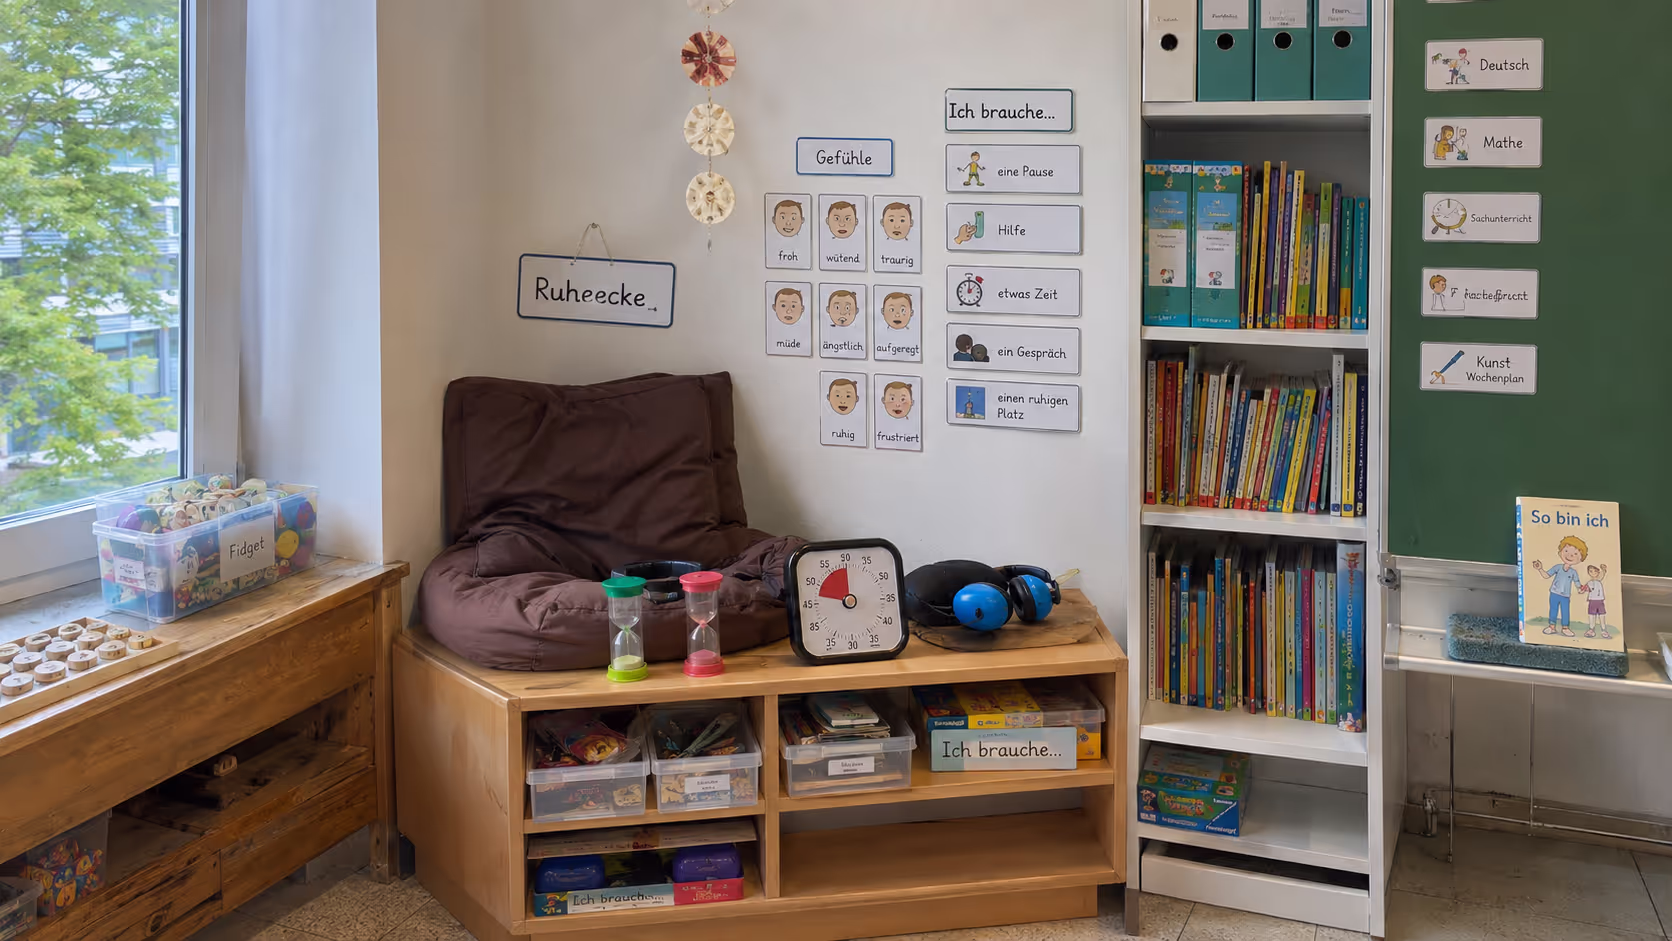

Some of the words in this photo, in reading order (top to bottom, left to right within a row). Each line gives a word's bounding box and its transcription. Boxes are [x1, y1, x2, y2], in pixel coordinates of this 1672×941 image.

[1479, 58, 1530, 72] Deutsch
[949, 102, 975, 119] Ich
[981, 103, 1055, 119] brauche...
[1483, 136, 1523, 149] Mathe
[816, 149, 872, 165] Gefühle
[997, 166, 1019, 177] eine
[1022, 165, 1054, 177] Pause
[1470, 213, 1533, 224] Sachunterricht
[998, 224, 1026, 236] Hilfe
[778, 250, 799, 262] froh
[826, 253, 860, 263] wütend
[881, 254, 914, 268] traurig
[535, 276, 646, 307] Ruheecke
[997, 288, 1030, 299] etwas
[1034, 287, 1058, 300] Zeit
[776, 339, 801, 349] müde
[822, 340, 864, 353] ängstlich
[876, 341, 919, 356] aufgeregt
[997, 347, 1013, 357] ein
[1017, 346, 1067, 361] Gespräch
[1476, 355, 1511, 369] Kunst
[1465, 372, 1525, 385] Wochenplan
[997, 393, 1025, 404] einen
[1028, 394, 1069, 409] ruhigen
[997, 408, 1025, 420] Platz
[831, 429, 855, 442] ruhig
[877, 431, 920, 443] frustriert
[1531, 509, 1550, 525] So
[1556, 511, 1581, 527] bin
[1586, 513, 1609, 528] ich
[229, 536, 265, 560] Fidget
[847, 641, 858, 650] 30
[942, 741, 972, 758] Ich
[978, 740, 1062, 758] brauche...
